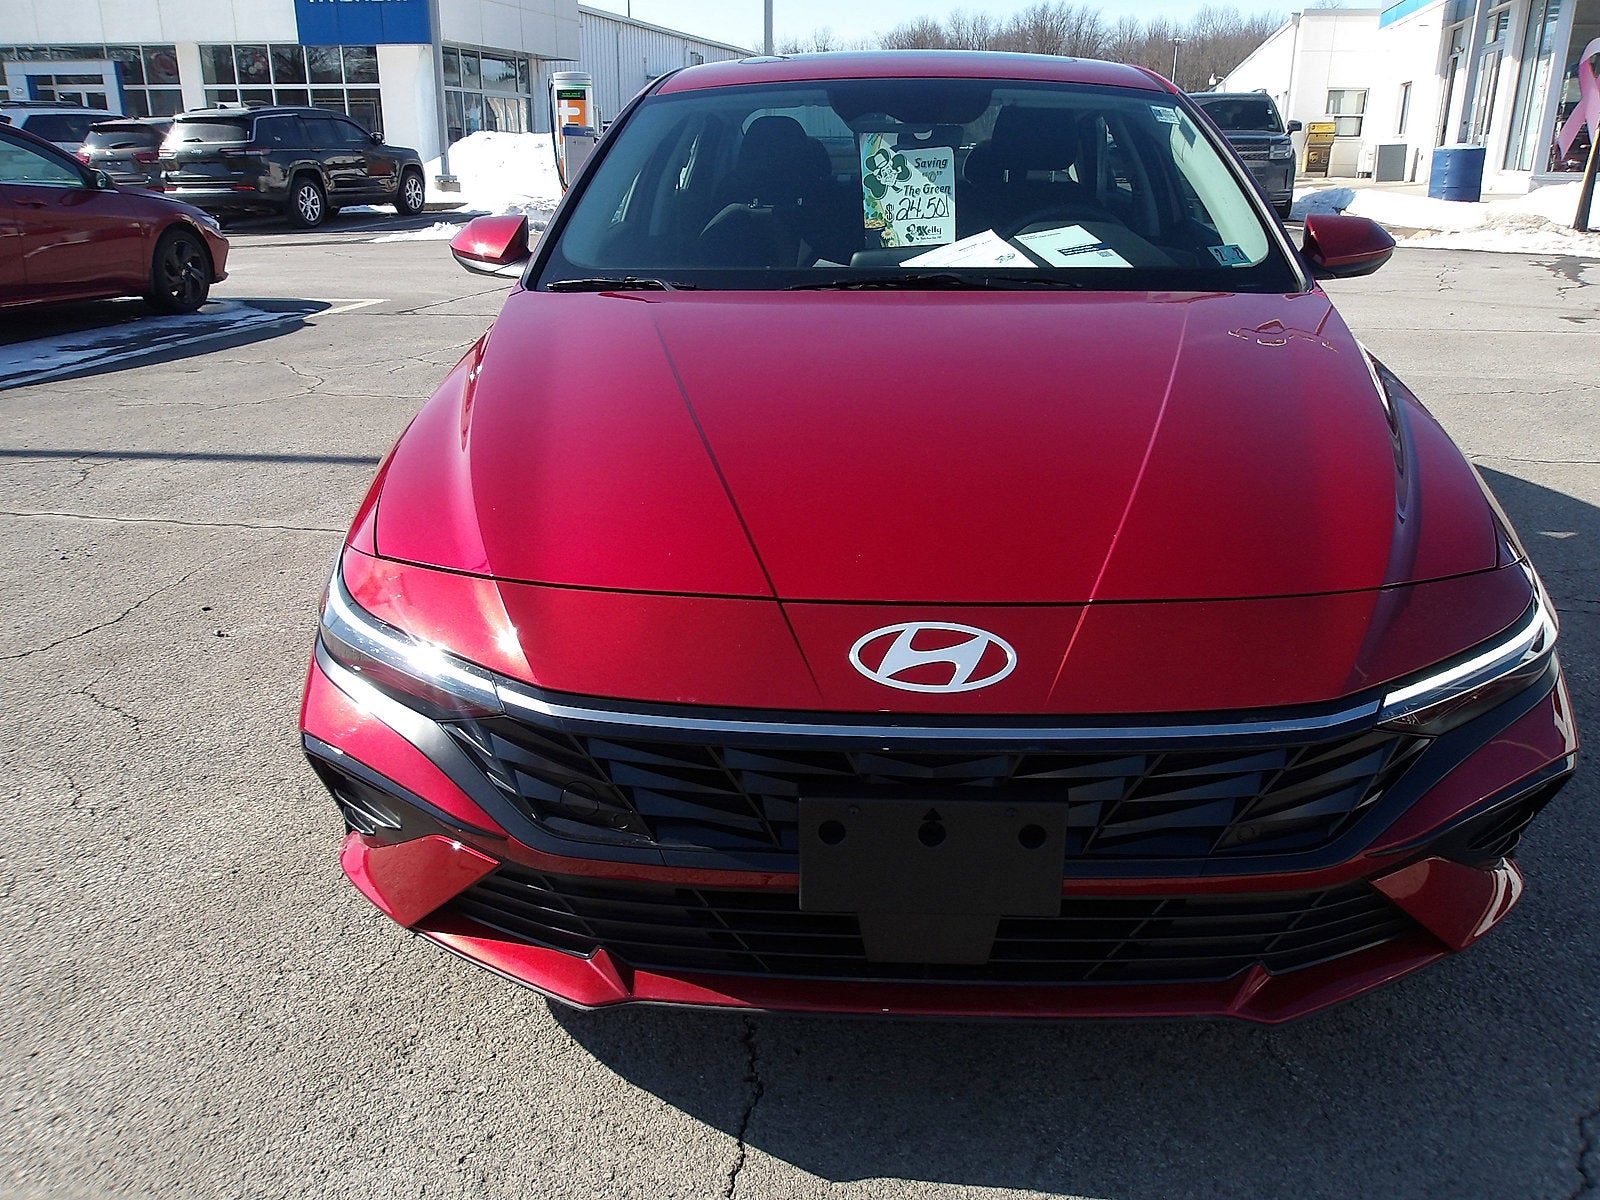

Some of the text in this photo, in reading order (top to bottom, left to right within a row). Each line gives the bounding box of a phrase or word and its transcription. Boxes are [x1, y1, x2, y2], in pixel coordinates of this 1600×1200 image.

[914, 157, 948, 169] Saving
[903, 184, 952, 197] The Green
